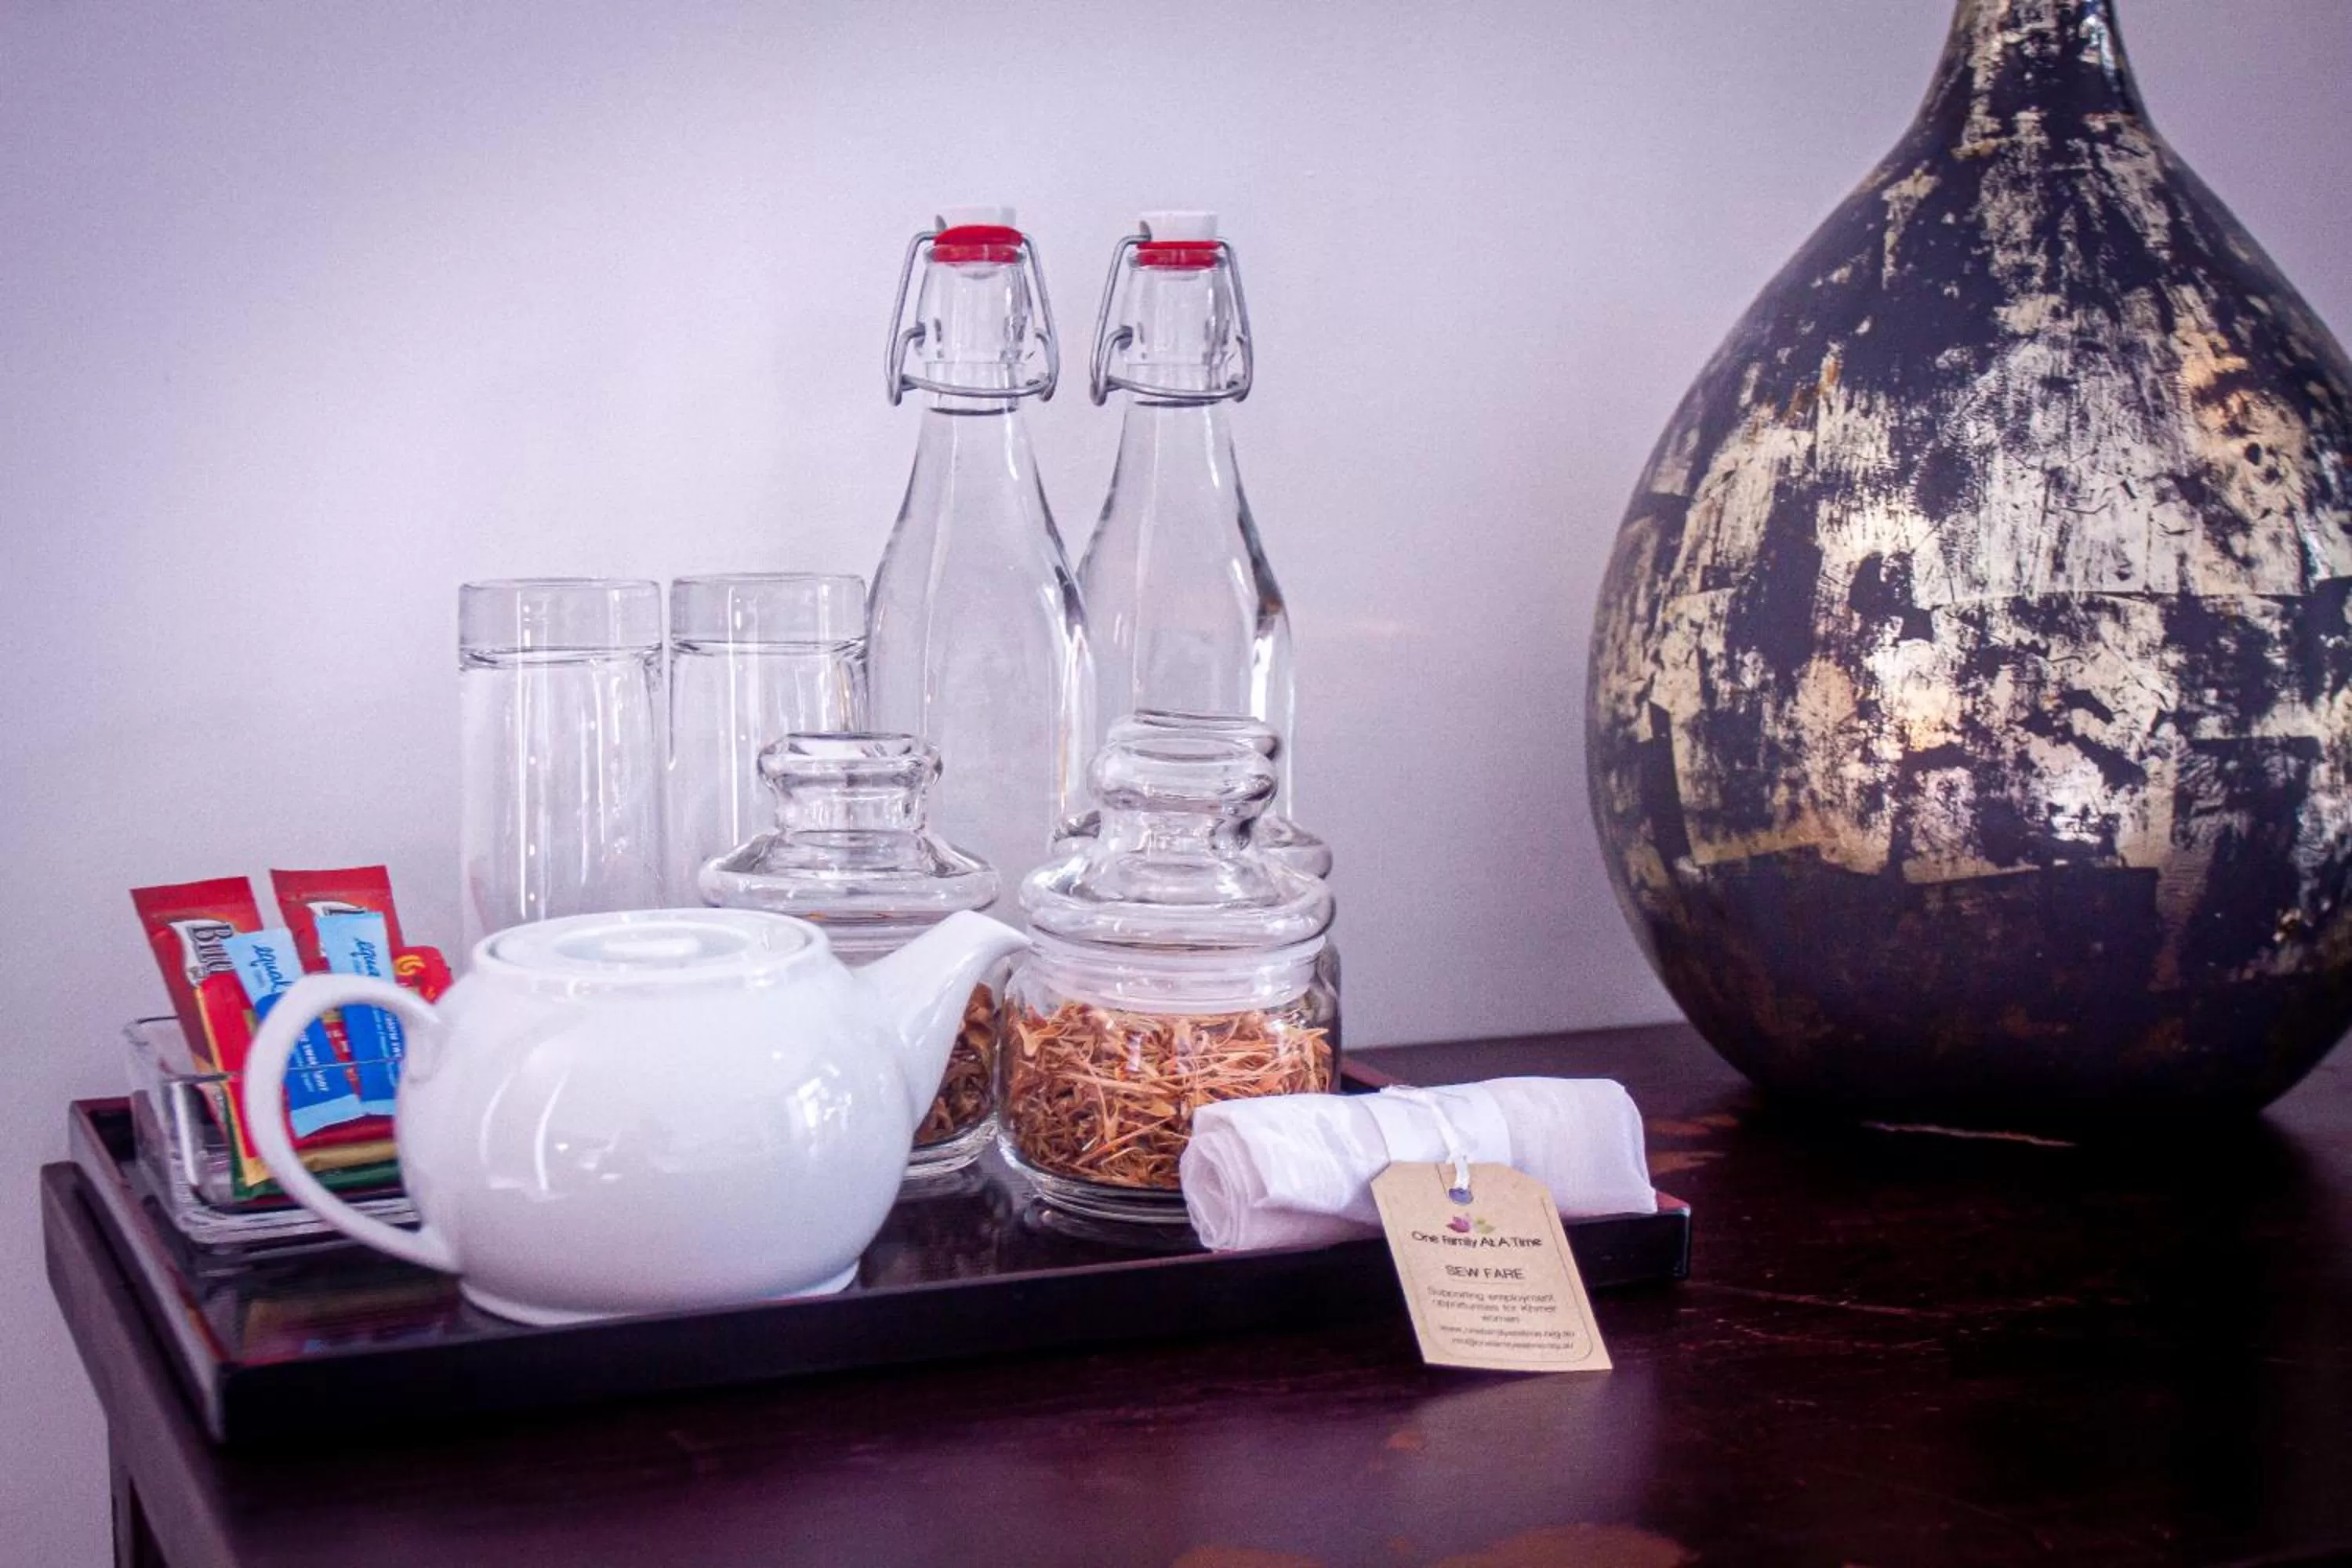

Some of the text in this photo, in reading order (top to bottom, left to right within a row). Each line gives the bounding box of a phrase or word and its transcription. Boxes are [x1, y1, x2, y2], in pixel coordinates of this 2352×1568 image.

[249, 944, 295, 992] equal
[350, 937, 381, 977] equa
[1411, 1230, 1439, 1243] One
[1442, 1235, 1478, 1247] Family
[1498, 1237, 1510, 1247] A
[1511, 1236, 1543, 1247] Time
[1444, 1264, 1526, 1279] SEW FARE
